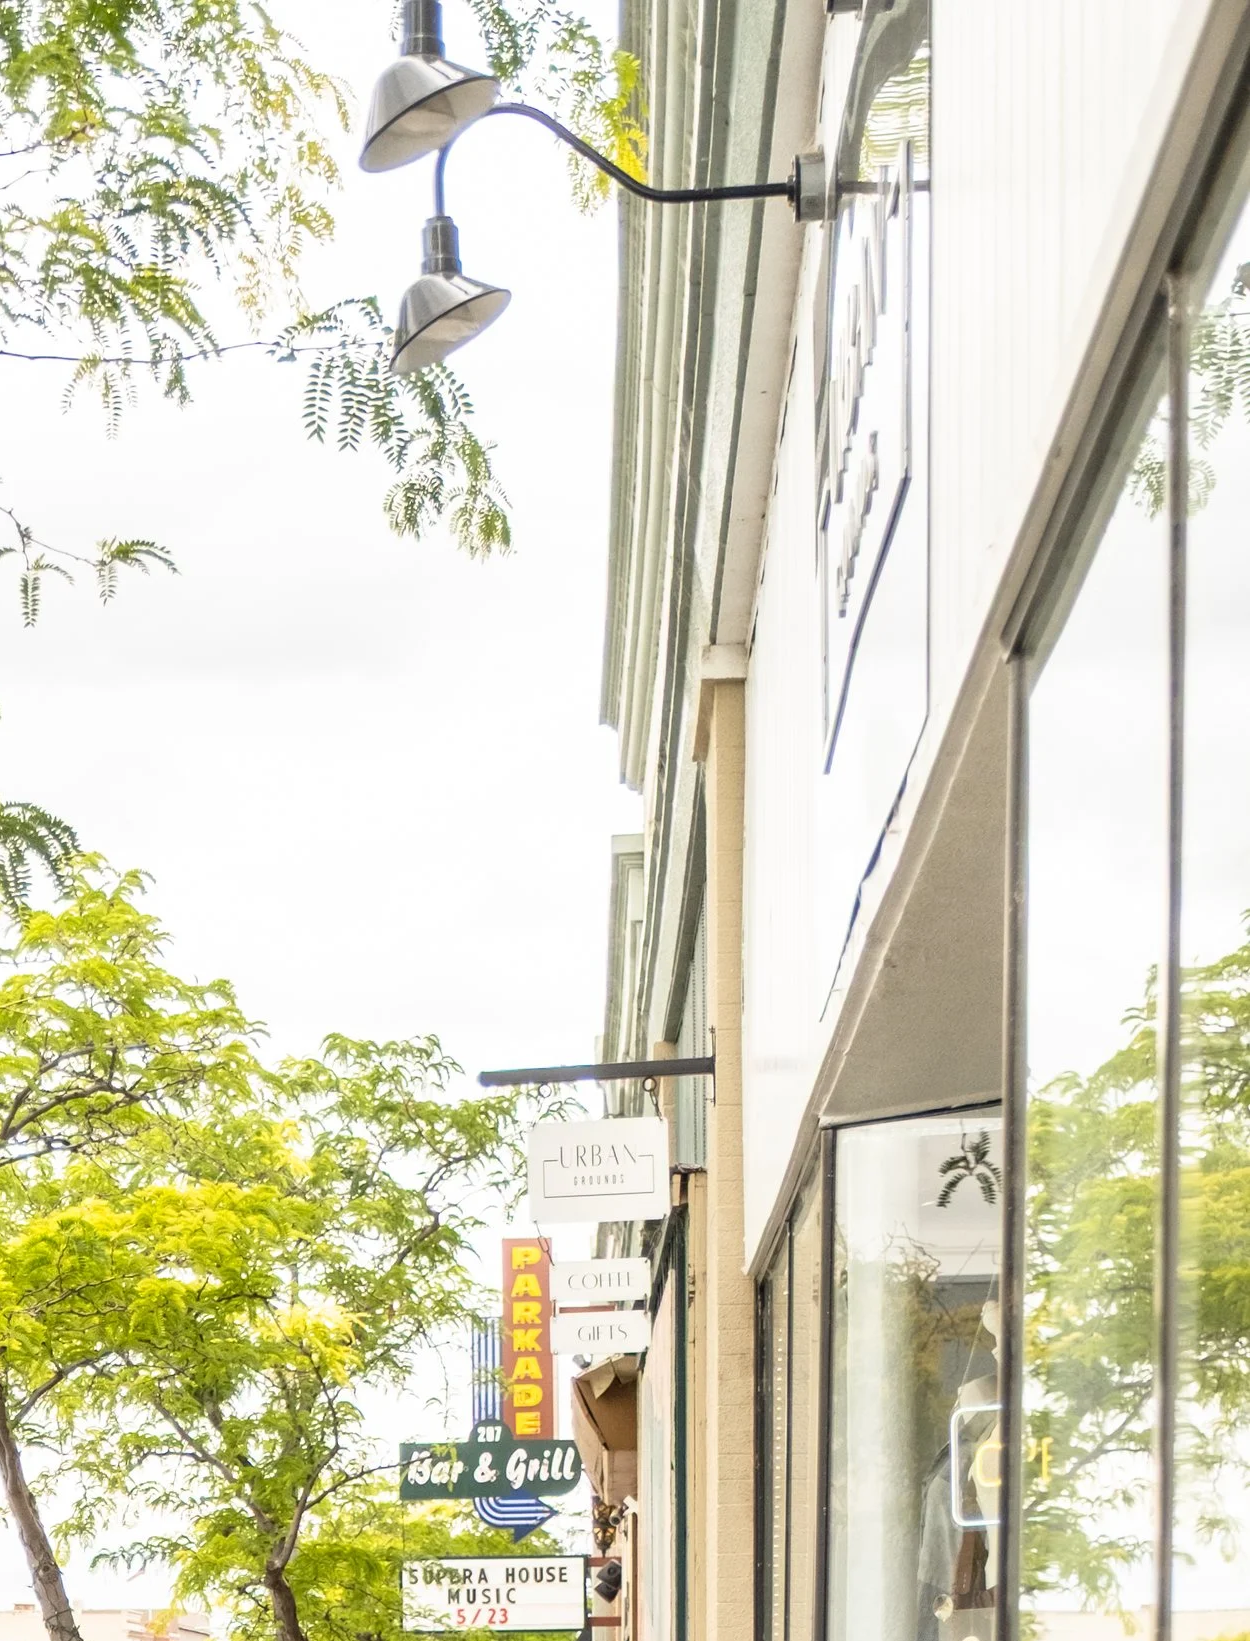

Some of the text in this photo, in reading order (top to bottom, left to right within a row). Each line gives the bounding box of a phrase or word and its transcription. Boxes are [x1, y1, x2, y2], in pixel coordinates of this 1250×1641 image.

[559, 1143, 637, 1169] URBAN
[573, 1173, 625, 1187] GROUNDS
[567, 1271, 633, 1291] COFFEE
[510, 1246, 544, 1436] PARKADE
[577, 1324, 629, 1342] GIFTS
[477, 1425, 502, 1444] 207
[407, 1446, 576, 1490] Bar & Grill
[505, 1566, 569, 1584] HOUSE
[447, 1587, 517, 1605] MUSIC
